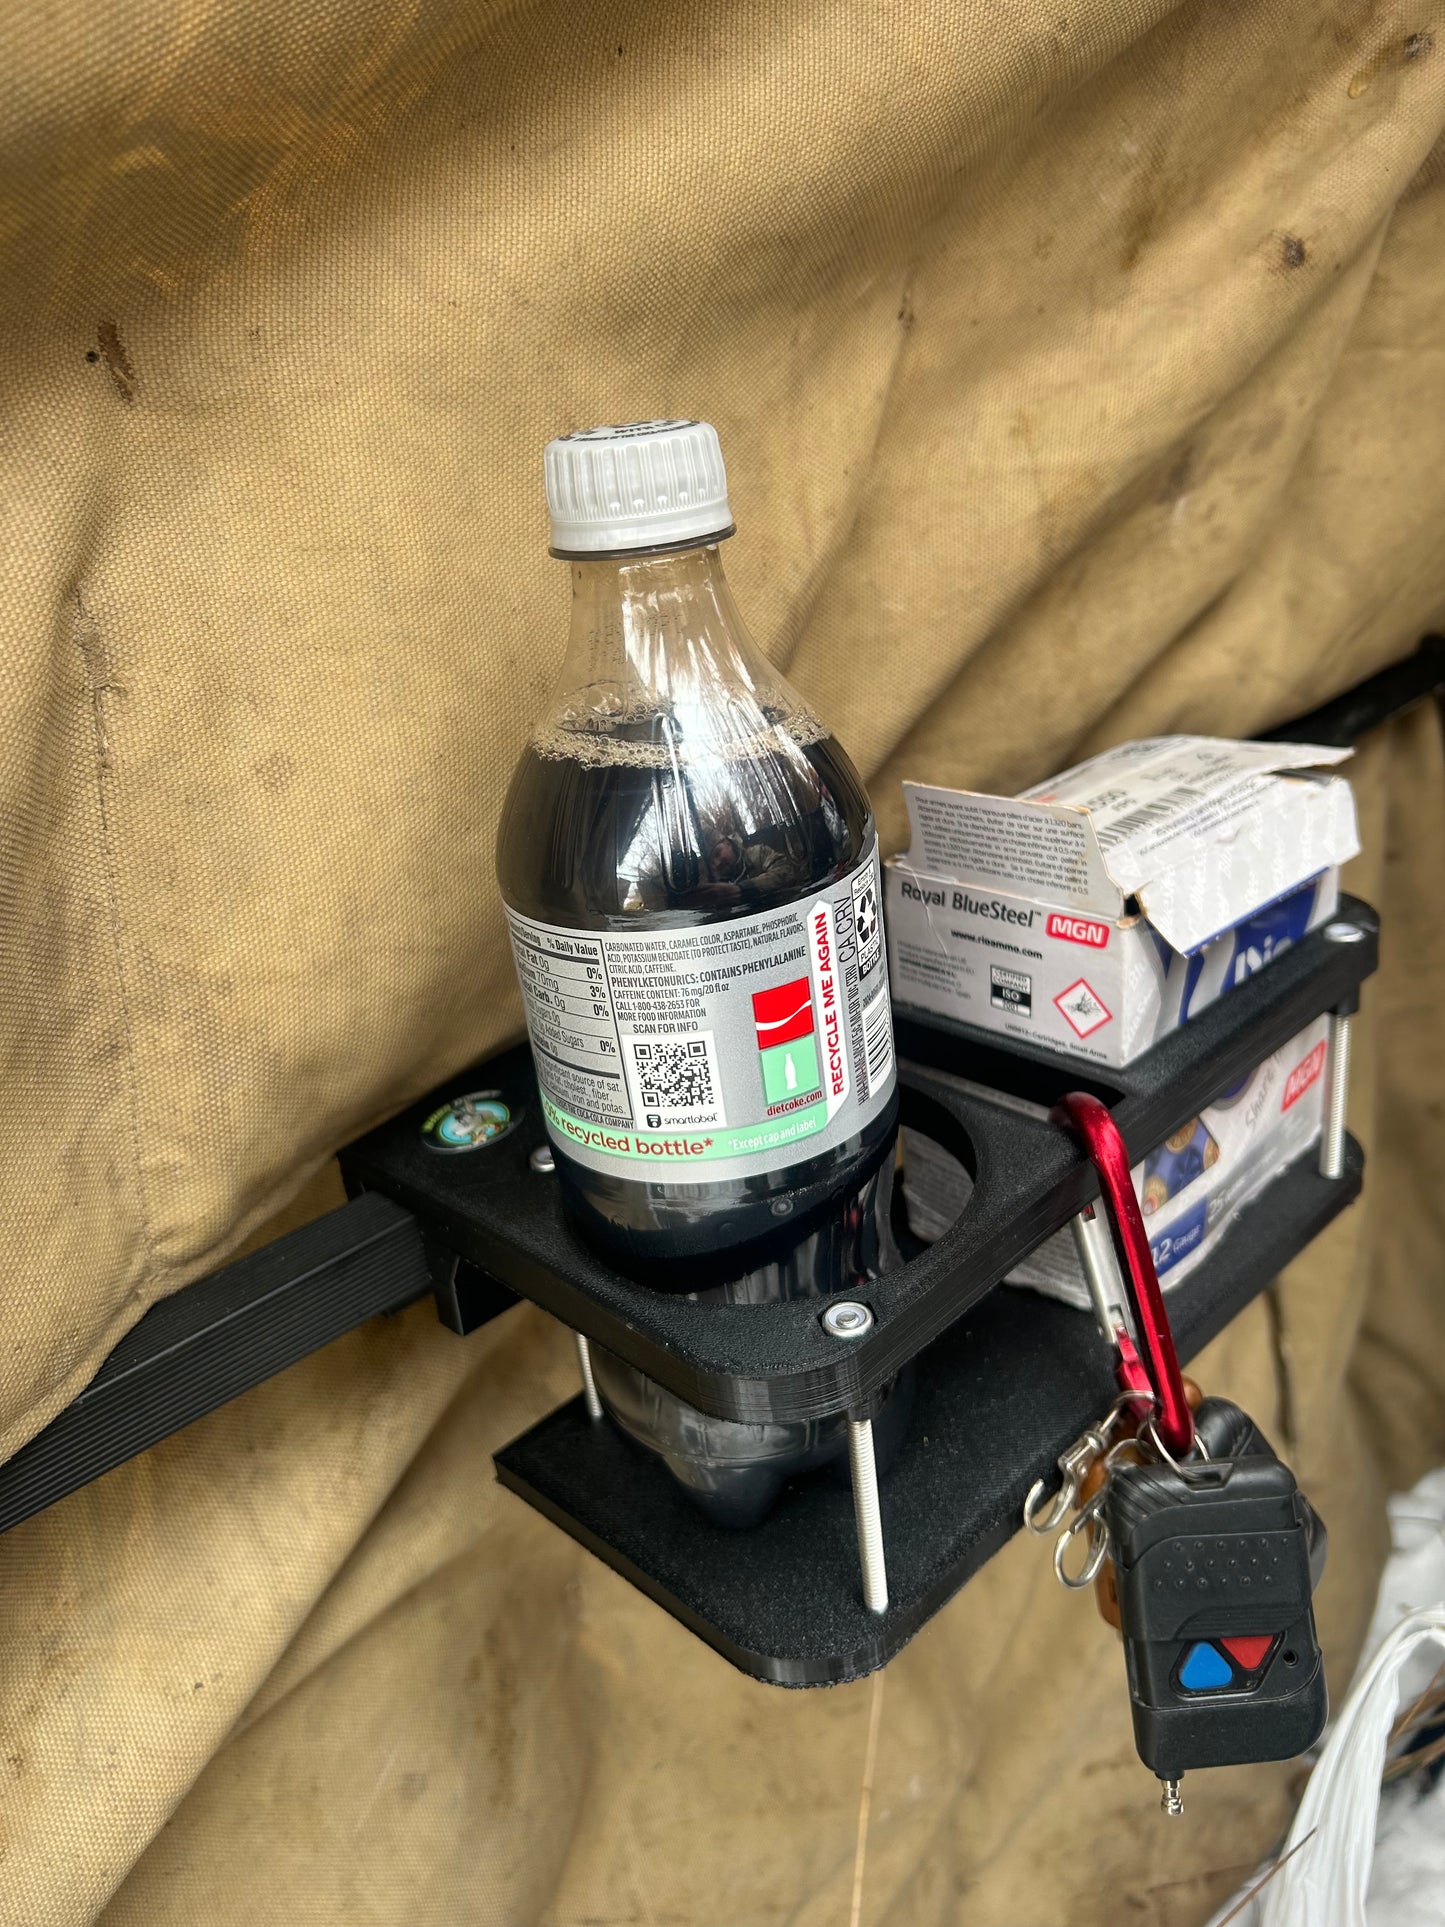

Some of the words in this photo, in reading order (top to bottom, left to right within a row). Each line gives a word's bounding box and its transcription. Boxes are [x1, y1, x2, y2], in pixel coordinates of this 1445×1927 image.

[900, 881, 946, 907] Royal
[833, 896, 854, 935] CRV
[604, 942, 645, 952] CARBONATED
[644, 941, 670, 952] WATER,
[669, 937, 700, 950] CARAMEL
[700, 933, 724, 947] COLOR,
[724, 924, 762, 942] ASPARTAME,
[762, 912, 800, 932] PHOSPHORIC
[607, 954, 624, 964] ACID,
[623, 952, 658, 963] POTASSIUM
[658, 950, 691, 962] BENZOATE
[690, 948, 701, 960] (TO
[702, 942, 732, 958] PROTECT
[730, 939, 753, 953] TASTE),
[752, 931, 780, 947] NATURAL
[780, 922, 806, 939] FLAVORS,
[814, 912, 832, 972] AGAIN
[950, 928, 1043, 960] www.rioammo.com
[1051, 917, 1104, 944] MGN
[555, 940, 574, 955] Daily
[574, 942, 598, 956] Value
[838, 932, 856, 963] CA
[526, 950, 538, 966] Fat
[586, 966, 603, 980] 0%
[608, 964, 628, 974] CITRIC
[628, 964, 645, 976] ACID,
[645, 962, 677, 974] CAFFEINE.
[611, 973, 700, 988] PHENYLKETONURICS:
[700, 965, 741, 983] CONTAINS
[742, 946, 806, 976] PHENYLALANINE
[862, 949, 881, 975] BOTTLE
[536, 971, 559, 992] 70mg
[589, 986, 606, 999] 3%
[614, 989, 646, 1000] CAFFEINE
[646, 988, 681, 1000] CONTENT:
[681, 988, 690, 998] 76
[690, 984, 714, 998] mg/20
[721, 983, 730, 992] oz
[821, 975, 836, 1009] ME
[1002, 988, 1020, 1002] ISO
[533, 986, 554, 1004] Carb.
[554, 995, 566, 1011] 0g
[593, 1004, 610, 1017] 0%
[615, 1002, 632, 1011] CALL
[632, 1000, 685, 1011] 1-800-438-2653
[686, 998, 701, 1008] FOR
[617, 1012, 638, 1022] MORE
[638, 1012, 657, 1022] FOOD
[657, 1008, 708, 1021] INFORMATION
[632, 1023, 658, 1034] SCAN
[658, 1022, 677, 1034] FOR
[676, 1020, 699, 1032] INFO
[561, 1030, 584, 1049] Sugars
[600, 1040, 616, 1054] 0%
[825, 1010, 844, 1096] RECYCLE
[572, 1072, 595, 1088] source
[596, 1079, 606, 1090] of
[606, 1081, 622, 1093] sat.
[586, 1098, 600, 1110] and
[601, 1102, 627, 1115] potas.
[766, 1090, 823, 1116] dietcoke.com
[577, 1106, 606, 1125] COCA-COLA
[605, 1116, 635, 1130] COMPANY
[562, 1116, 631, 1154] recycled
[763, 1132, 780, 1146] cap
[780, 1126, 796, 1140] and
[796, 1118, 816, 1134] label
[1151, 1238, 1173, 1267] 12
